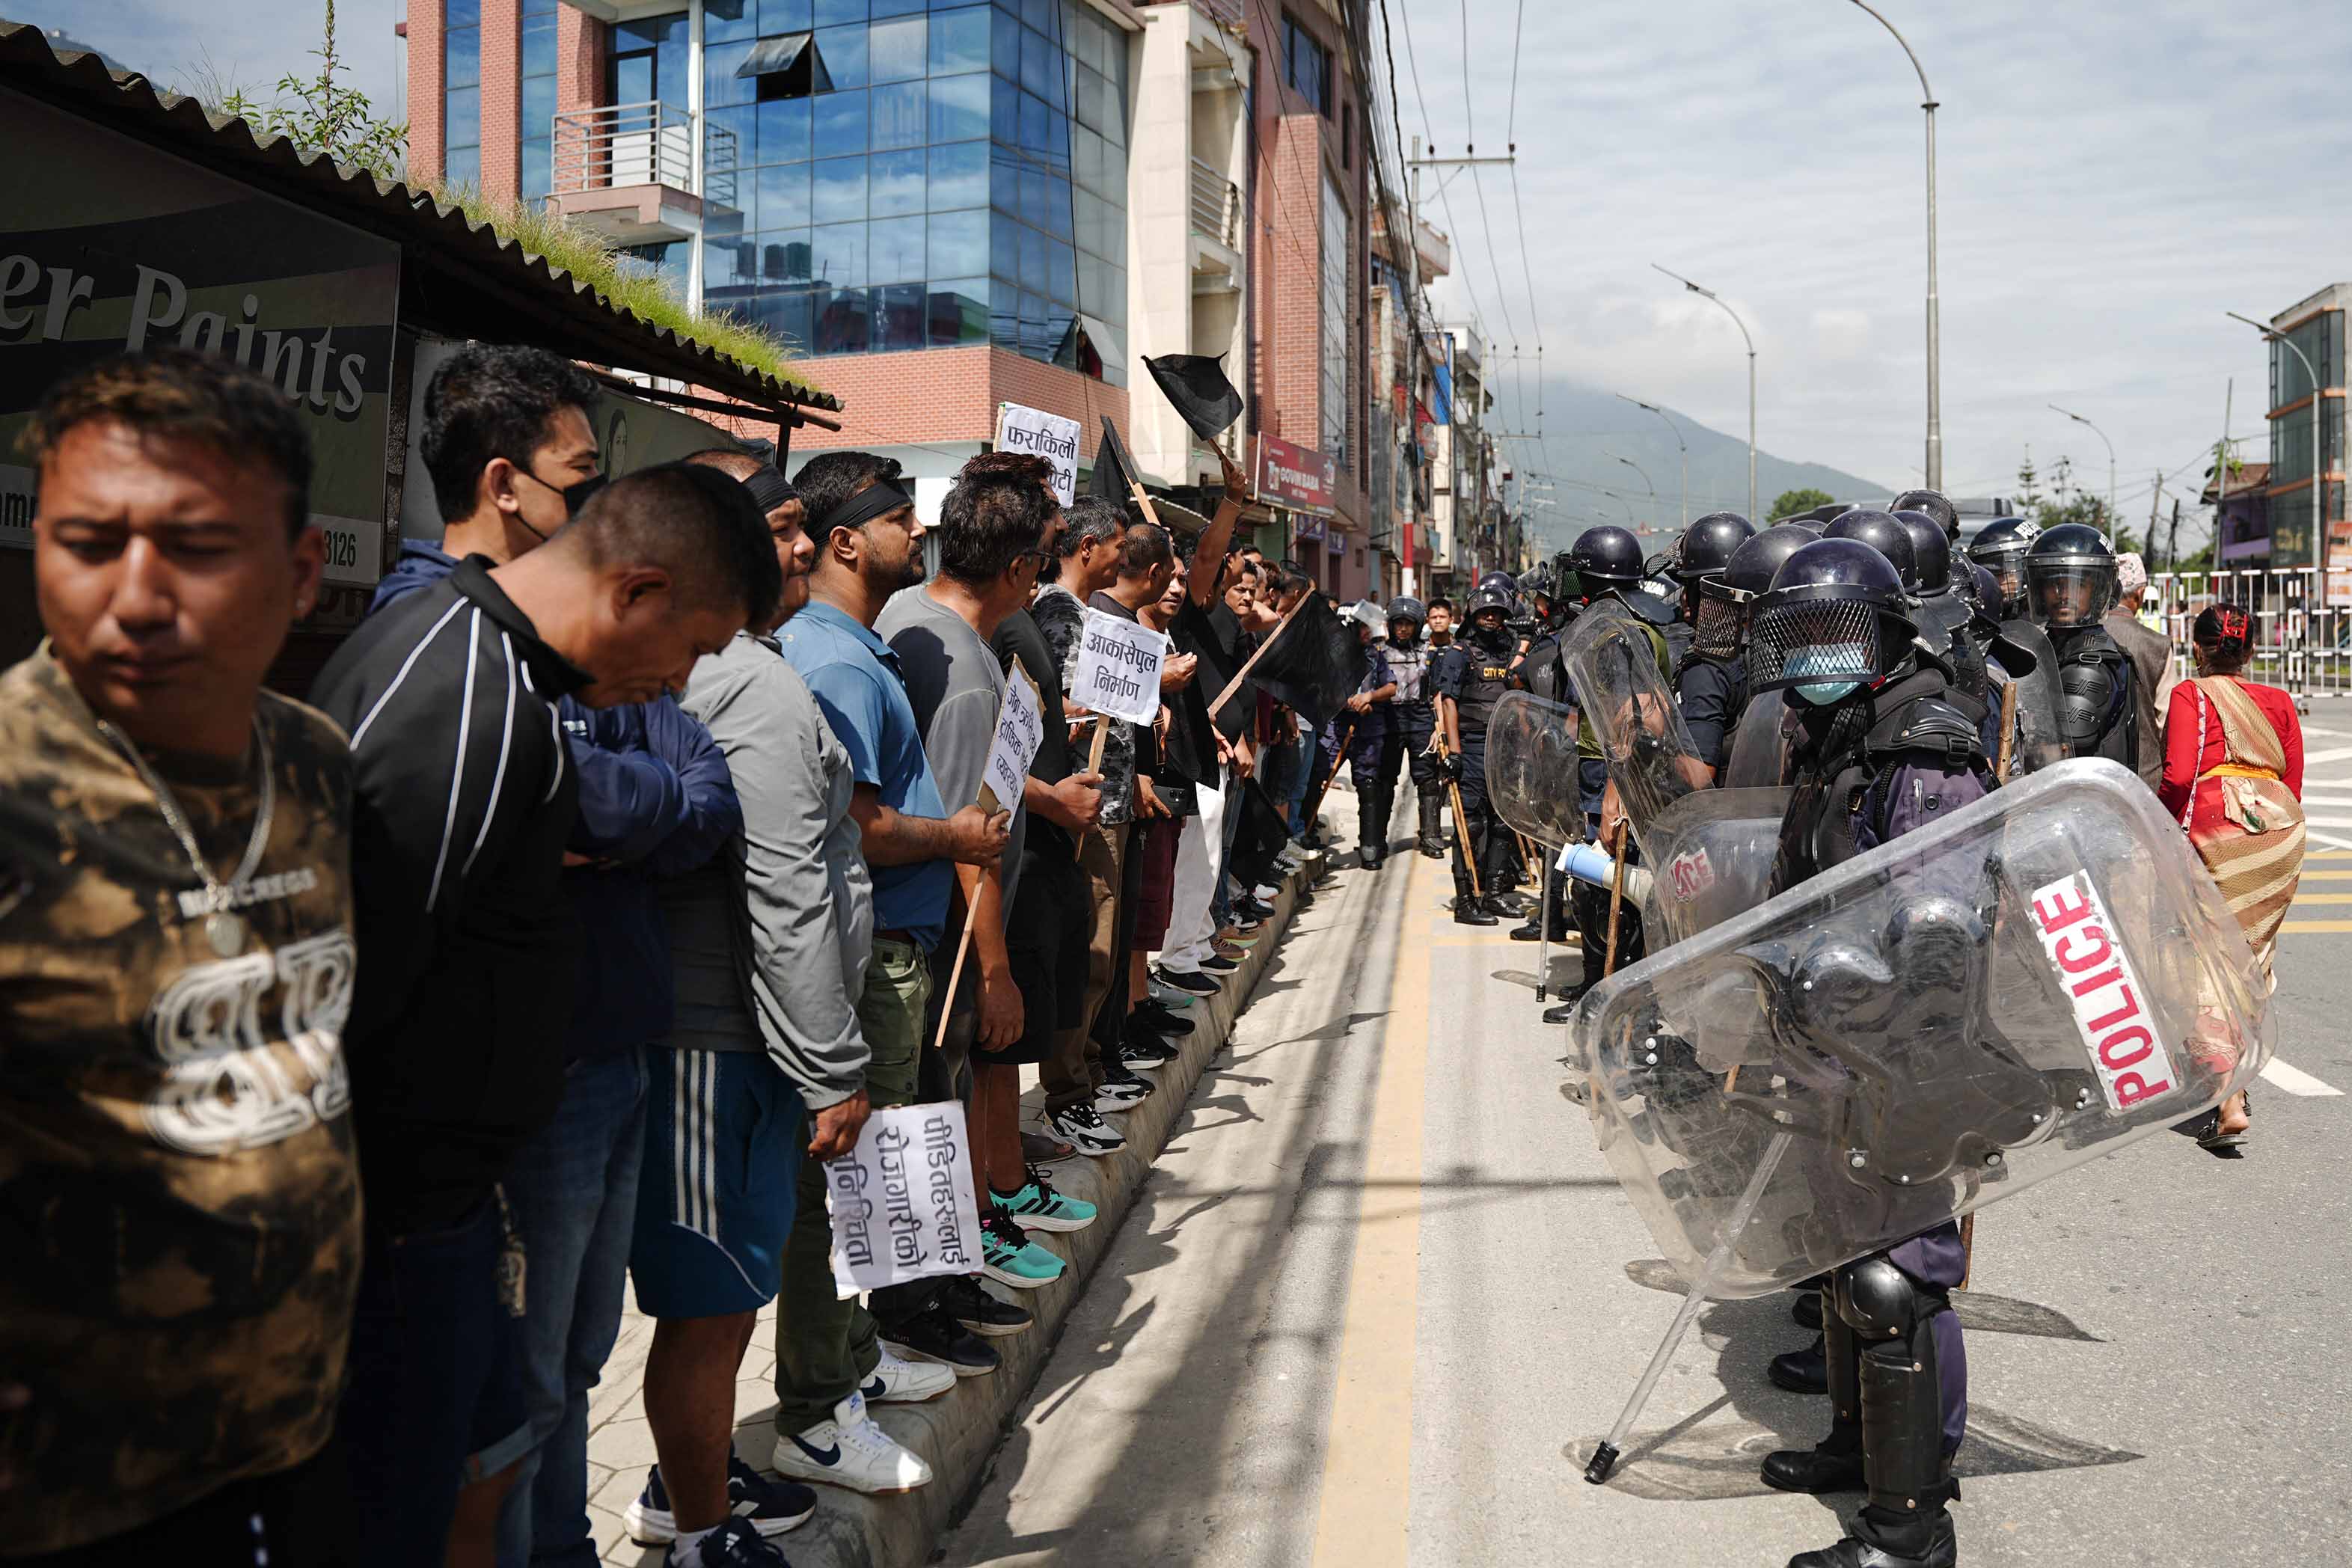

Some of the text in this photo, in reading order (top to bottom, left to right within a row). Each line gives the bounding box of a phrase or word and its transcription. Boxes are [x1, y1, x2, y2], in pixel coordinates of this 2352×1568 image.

[126, 263, 367, 413] Paints
[1008, 426, 1076, 460] फराकिलो
[1087, 632, 1158, 673] आकासेपुल
[1484, 667, 1496, 678] CITY
[1094, 665, 1141, 701] निर्माण
[2032, 886, 2169, 1107] POLICE
[875, 1125, 928, 1268] रोजगारीको
